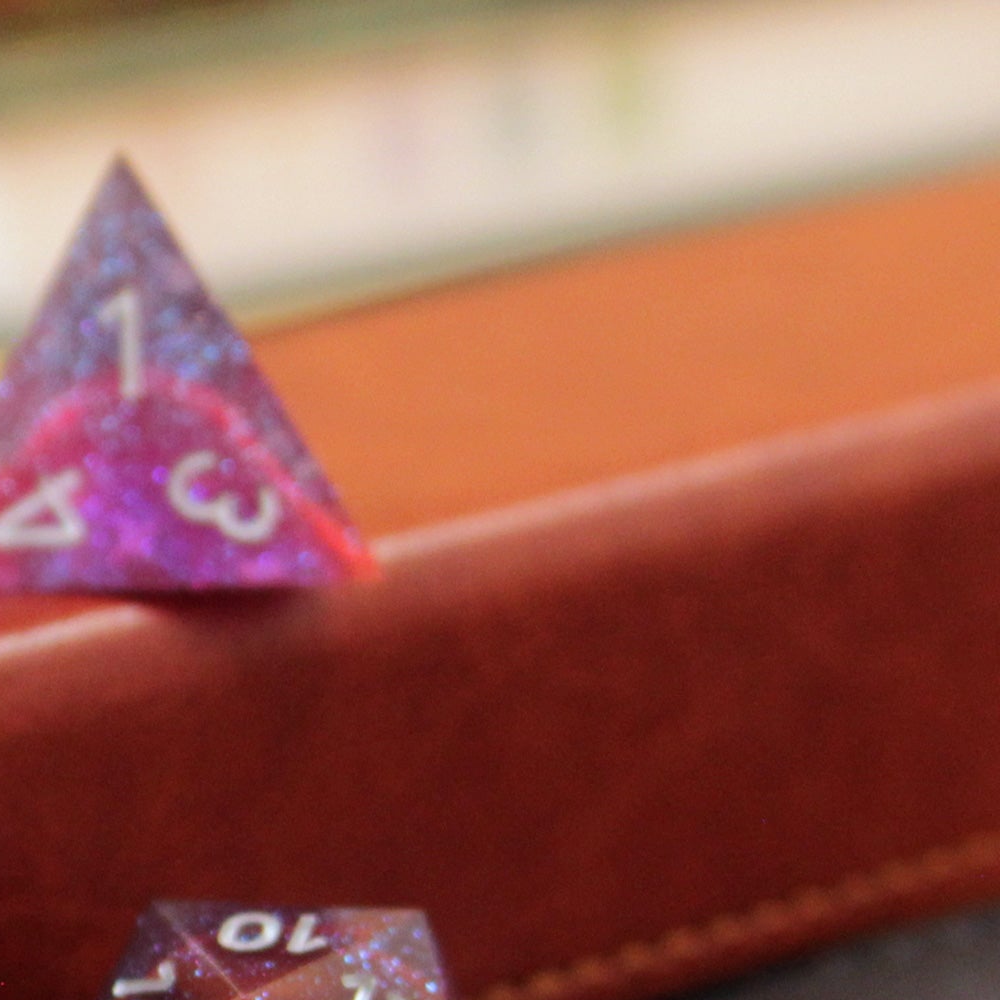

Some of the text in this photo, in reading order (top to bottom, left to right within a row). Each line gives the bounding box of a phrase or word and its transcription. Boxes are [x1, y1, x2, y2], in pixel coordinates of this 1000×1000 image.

[98, 289, 142, 400] 1
[169, 450, 279, 543] 3
[217, 911, 328, 955] 10
